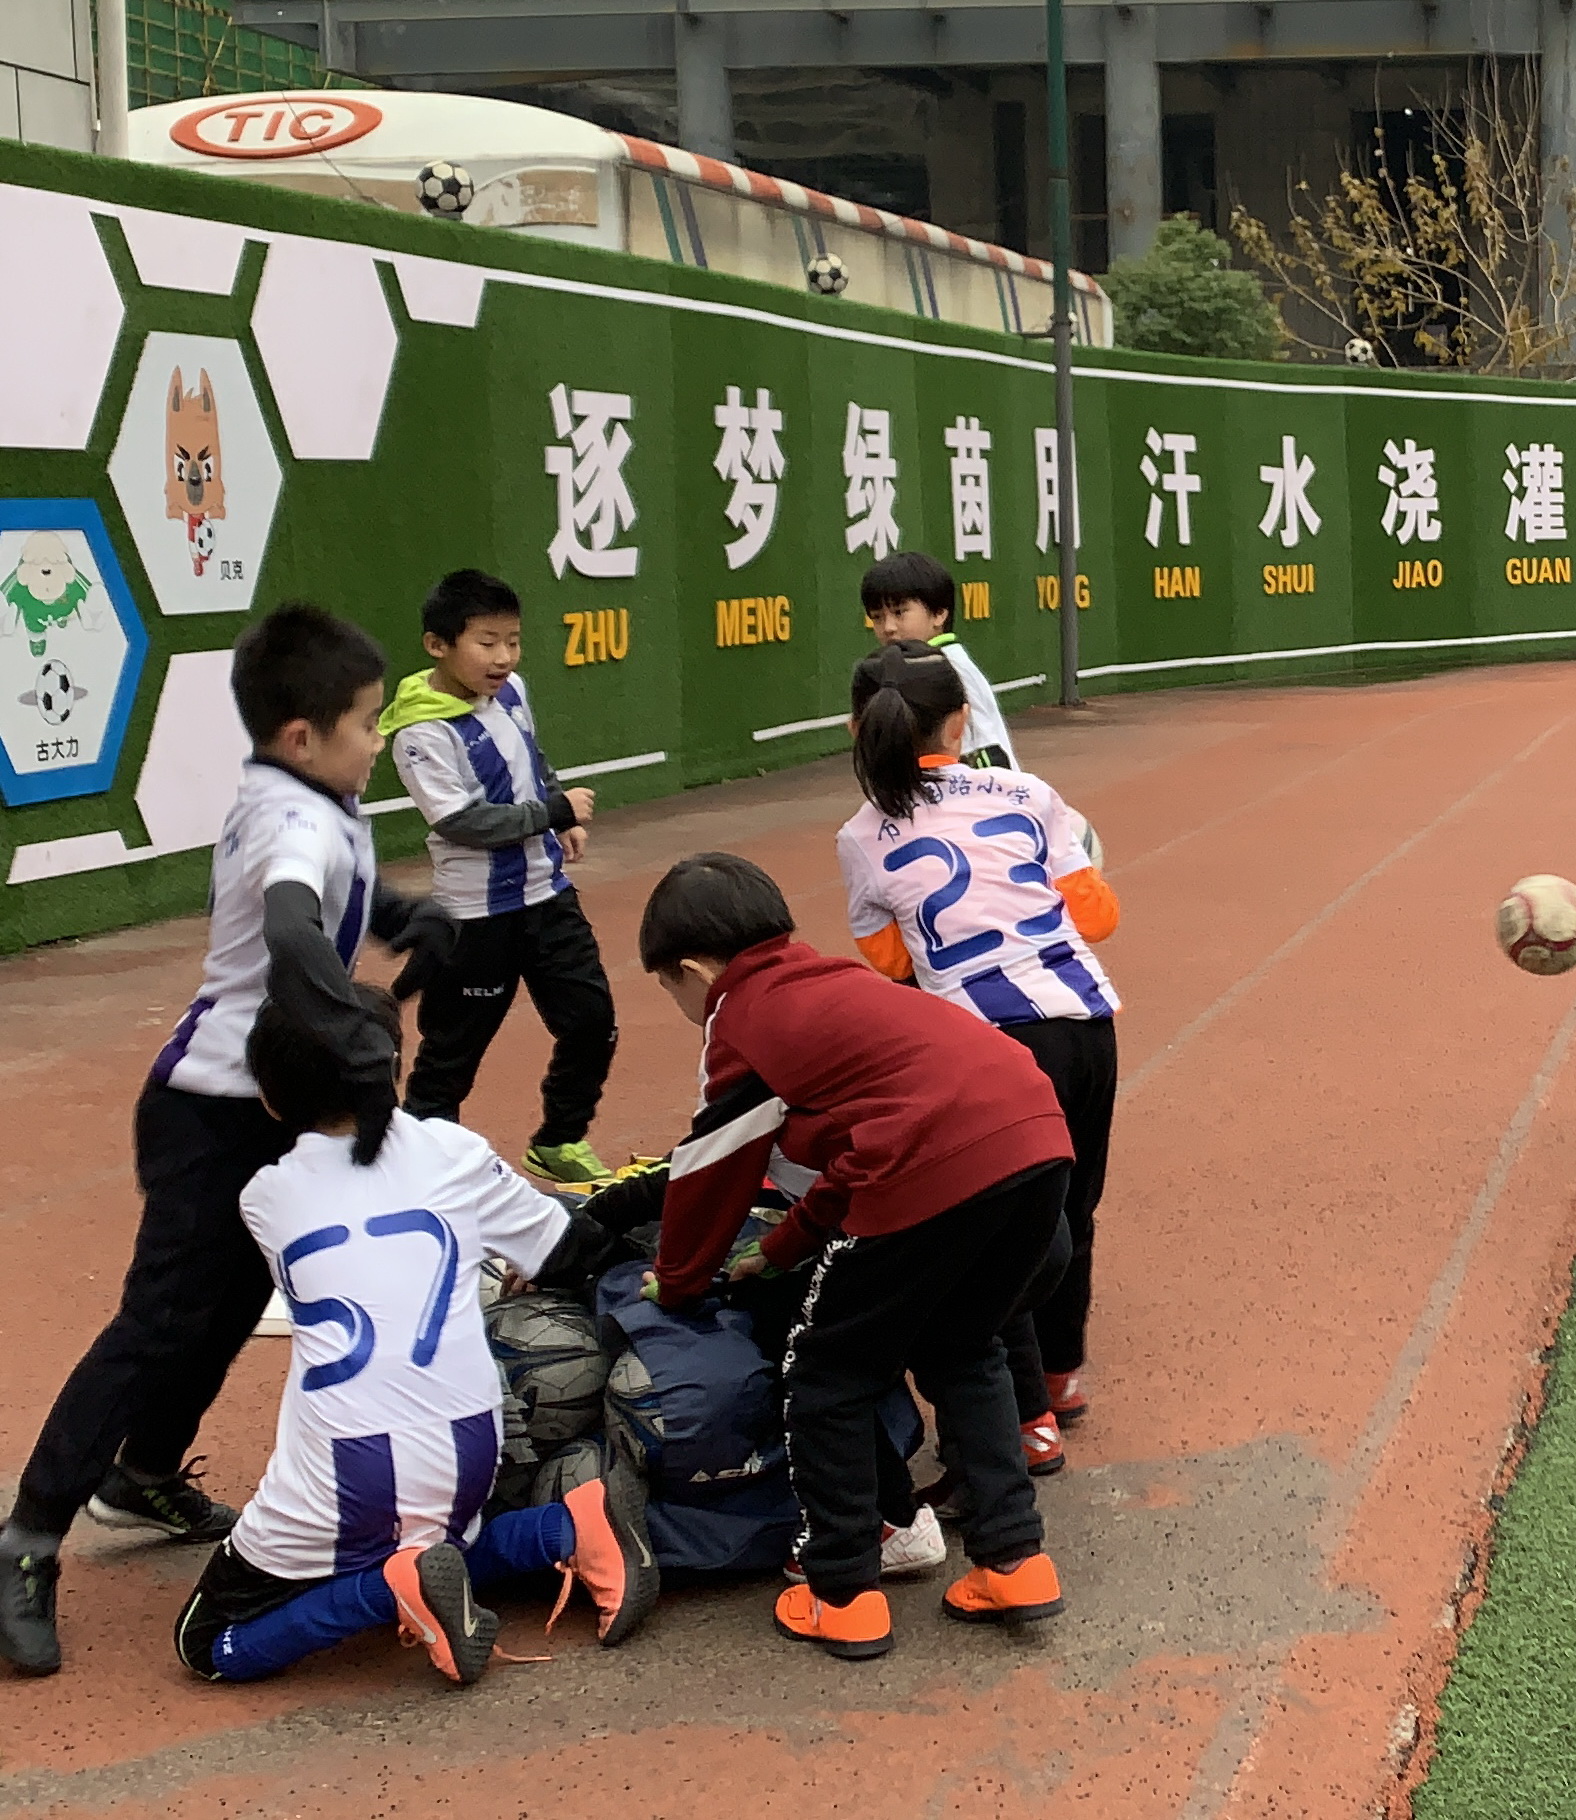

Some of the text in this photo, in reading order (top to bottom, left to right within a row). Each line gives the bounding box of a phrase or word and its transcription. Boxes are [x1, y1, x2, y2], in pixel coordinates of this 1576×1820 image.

[224, 108, 335, 142] TIC
[220, 560, 244, 581] 贝克
[563, 607, 630, 667] ZHU
[715, 595, 792, 648] MENG
[961, 581, 991, 621] YIN
[1036, 574, 1092, 611] YOG
[1154, 566, 1201, 599] HAN
[1262, 563, 1316, 595] SHUI
[1392, 559, 1444, 589] JIAO
[1505, 556, 1572, 586] GUAN
[35, 736, 79, 762] 古大力
[883, 812, 1064, 971] 23
[277, 1208, 459, 1393] 57
